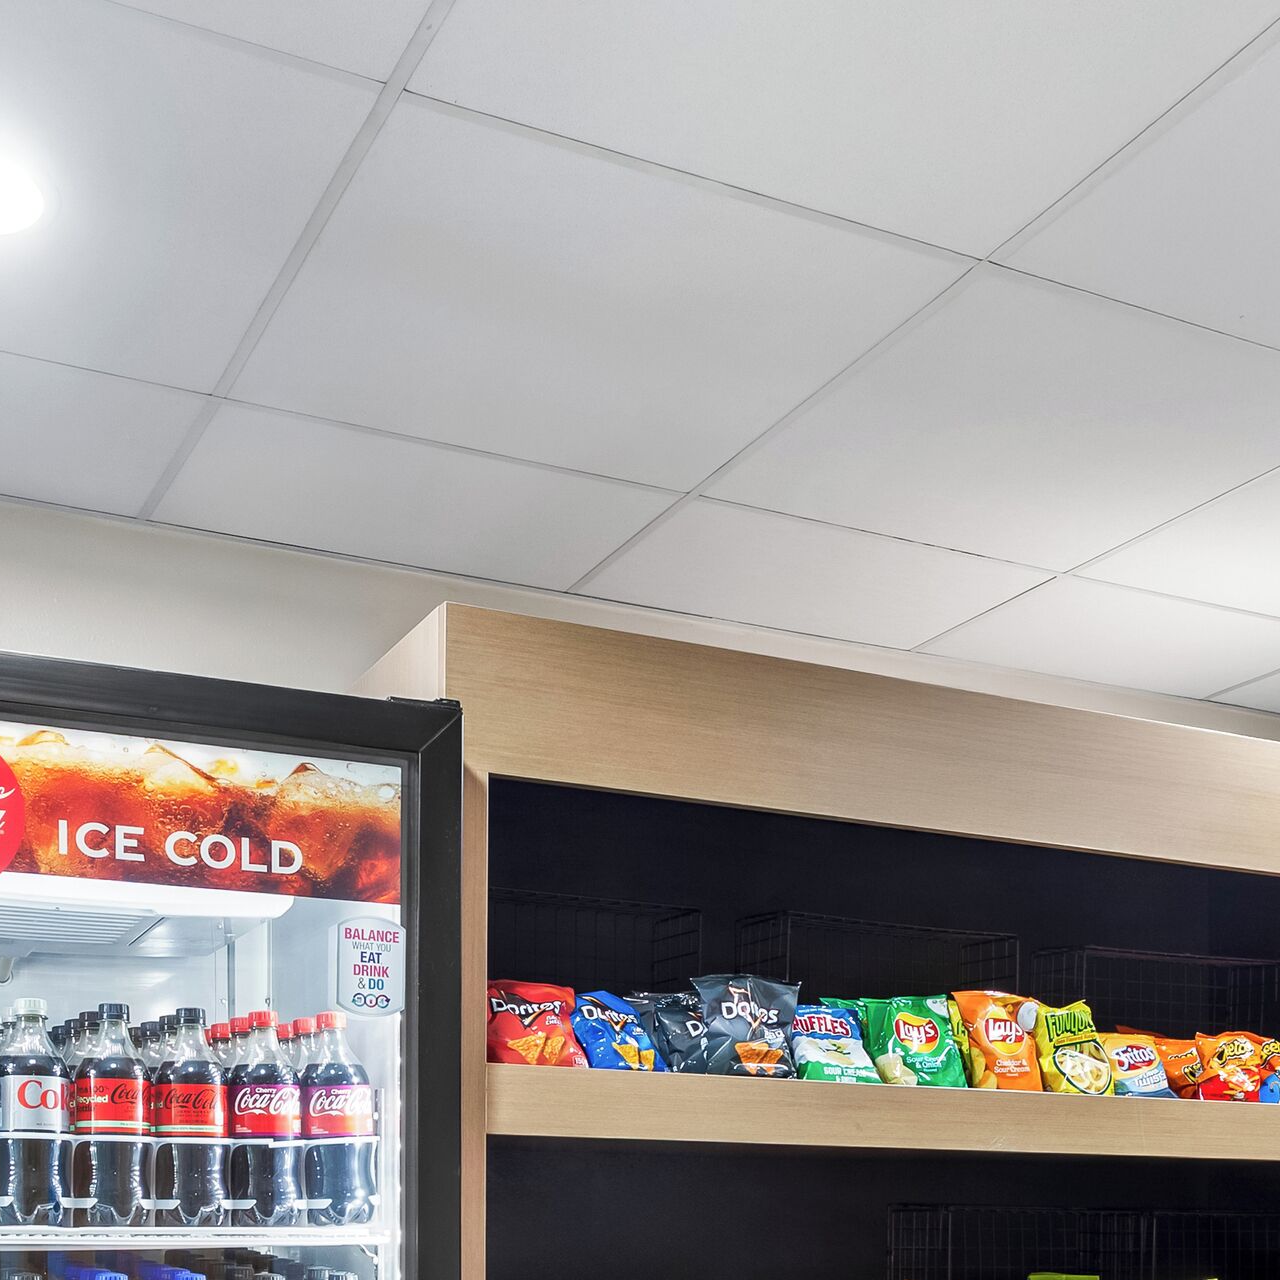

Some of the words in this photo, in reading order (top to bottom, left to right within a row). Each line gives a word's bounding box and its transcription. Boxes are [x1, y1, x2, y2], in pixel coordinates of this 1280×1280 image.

[57, 818, 145, 863] ICE
[164, 832, 303, 876] COLD
[345, 927, 399, 943] BALANCE
[352, 941, 374, 950] WHAT
[376, 943, 391, 952] YOU
[353, 964, 389, 978] DRINK
[358, 977, 365, 989] &
[368, 978, 384, 990] DO
